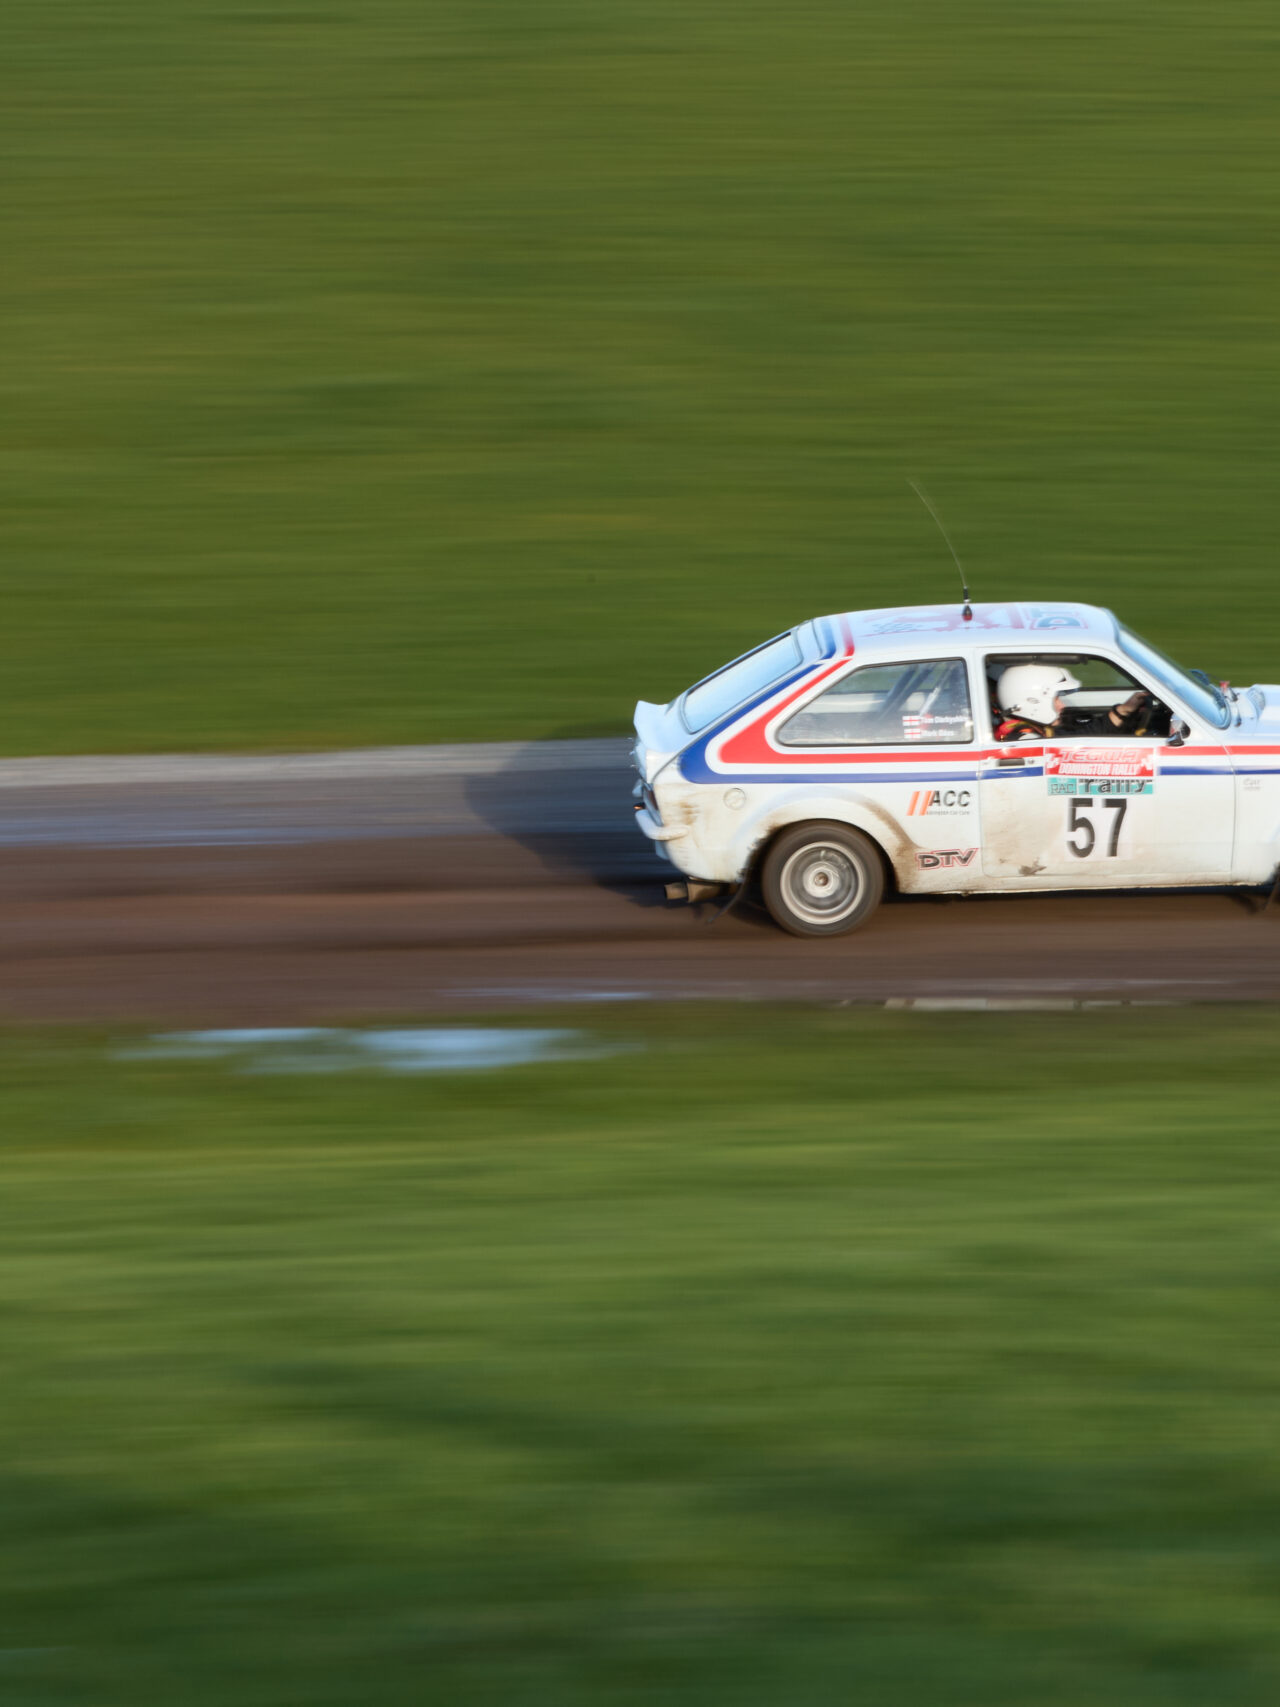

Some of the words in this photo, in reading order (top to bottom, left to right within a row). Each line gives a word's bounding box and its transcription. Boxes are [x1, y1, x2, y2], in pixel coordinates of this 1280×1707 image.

[1059, 763, 1110, 775] DONINGTON
[1111, 764, 1139, 775] RALLY
[1050, 783, 1075, 793] RAC
[1082, 778, 1147, 793] rally
[928, 790, 971, 807] ACC
[1067, 797, 1128, 858] 57
[916, 848, 978, 869] DTV
